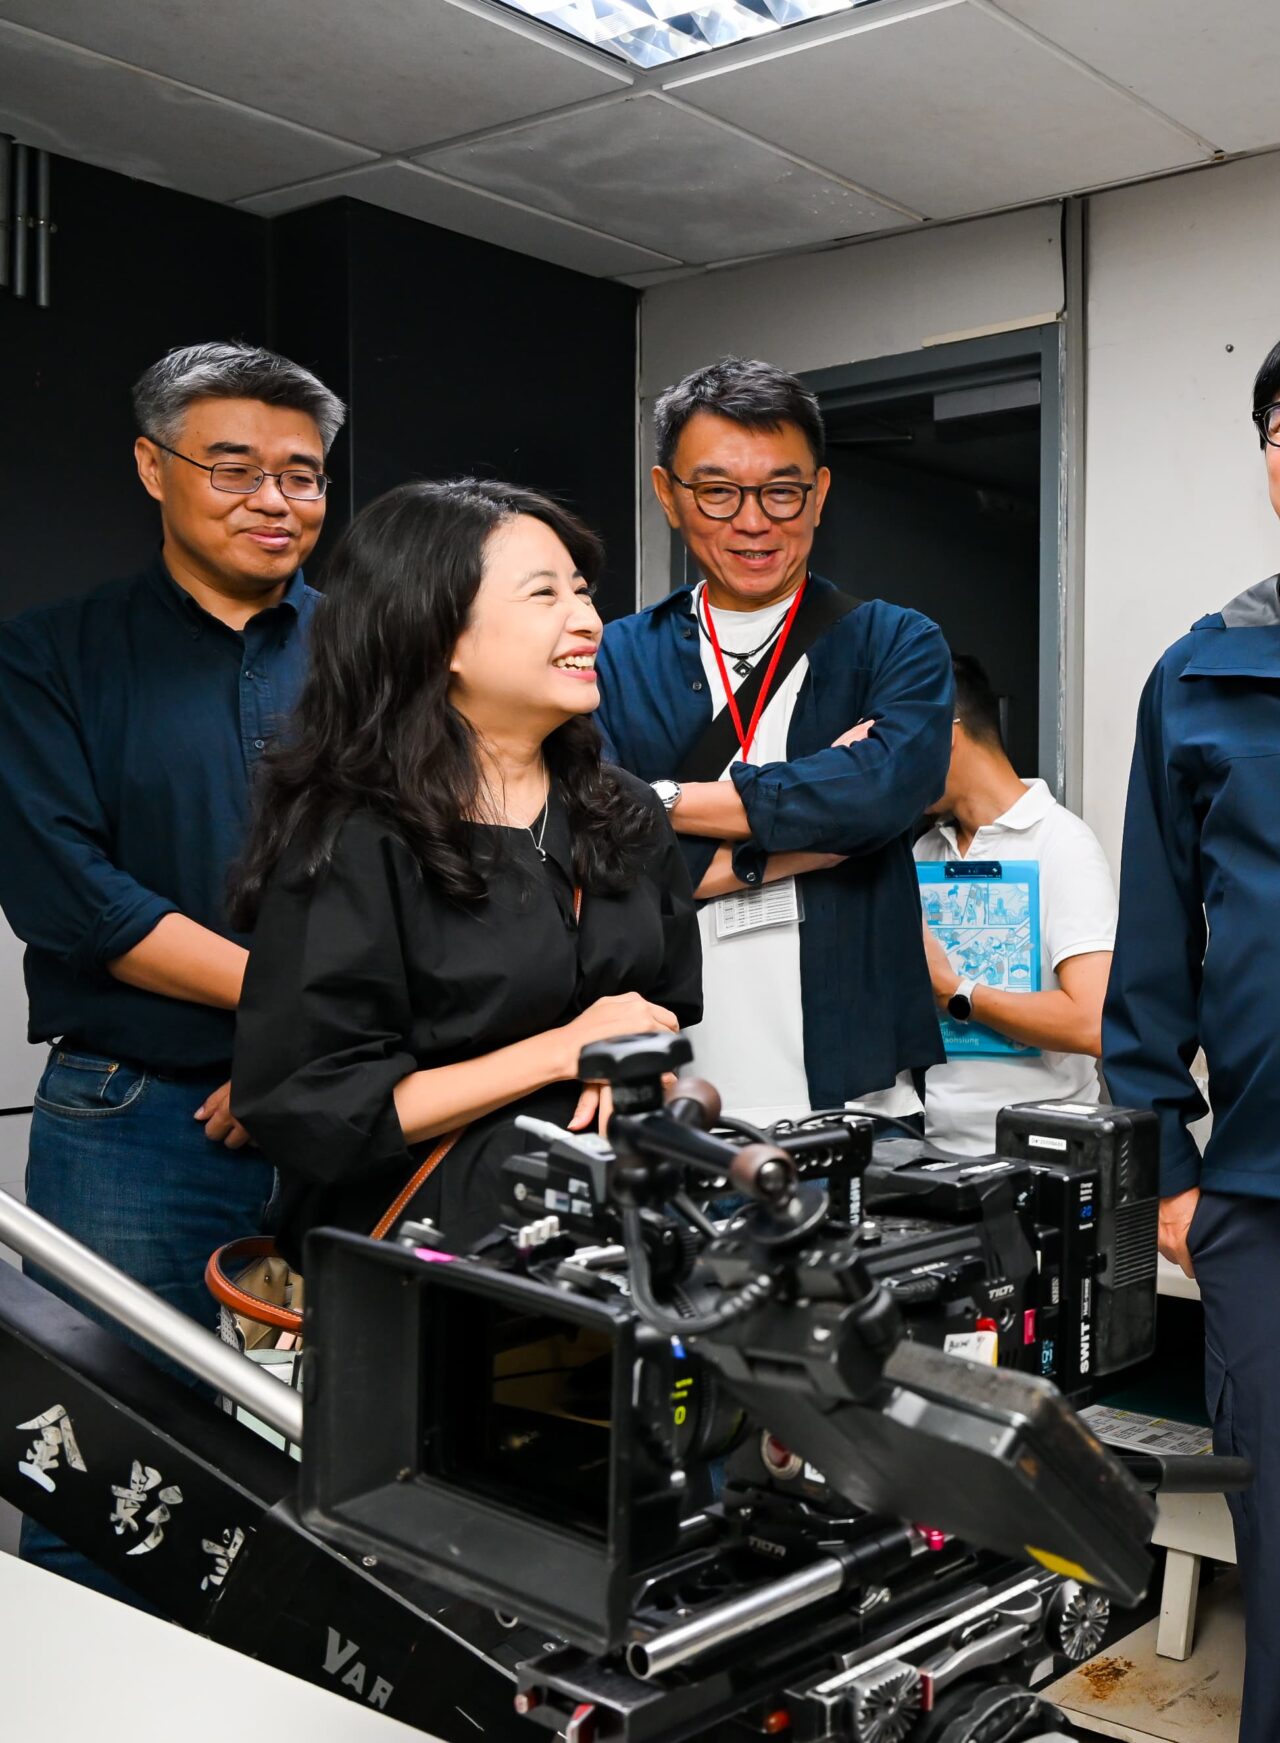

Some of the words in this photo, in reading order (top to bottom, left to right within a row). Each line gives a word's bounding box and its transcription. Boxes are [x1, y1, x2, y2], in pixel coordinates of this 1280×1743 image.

[944, 1037, 979, 1046] aohsiung
[1080, 1323, 1090, 1374] SWIT
[749, 1536, 786, 1556] TILTA
